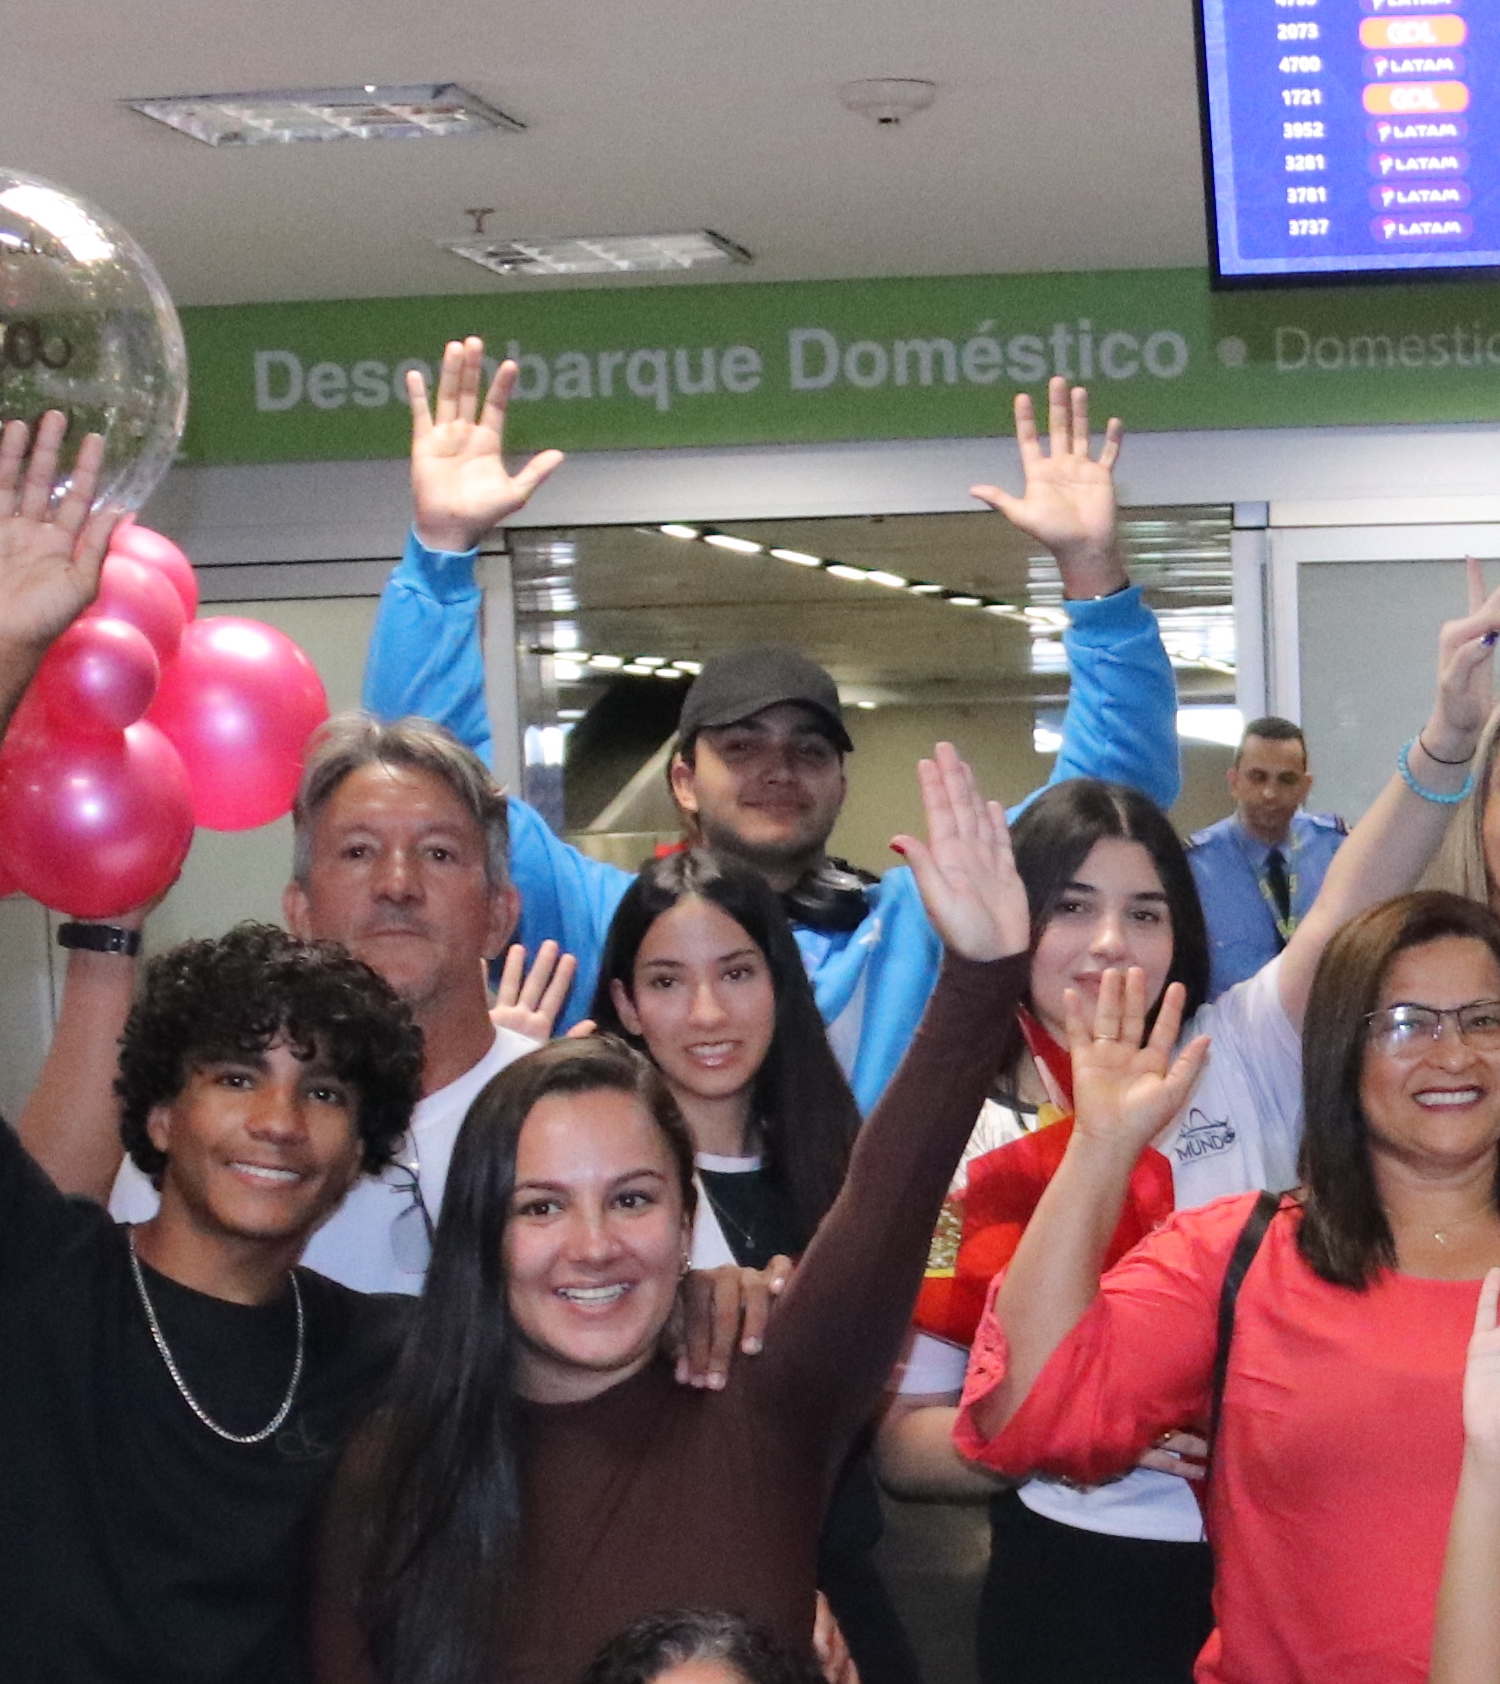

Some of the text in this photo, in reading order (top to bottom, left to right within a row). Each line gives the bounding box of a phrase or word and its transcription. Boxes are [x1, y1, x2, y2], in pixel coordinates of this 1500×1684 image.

[1277, 22, 1320, 41] 2073
[1390, 58, 1456, 73] LATAM
[1282, 89, 1323, 107] 1721
[1284, 121, 1326, 139] 3952
[1394, 124, 1459, 139] LATAM
[1395, 156, 1460, 172] LATAM
[1397, 189, 1461, 204] LATAM
[1289, 219, 1331, 237] 3737
[1398, 221, 1463, 236] LATAM
[254, 340, 762, 411] Desebarque
[787, 320, 1188, 391] Doméstico
[1174, 1128, 1236, 1161] MUNDO
